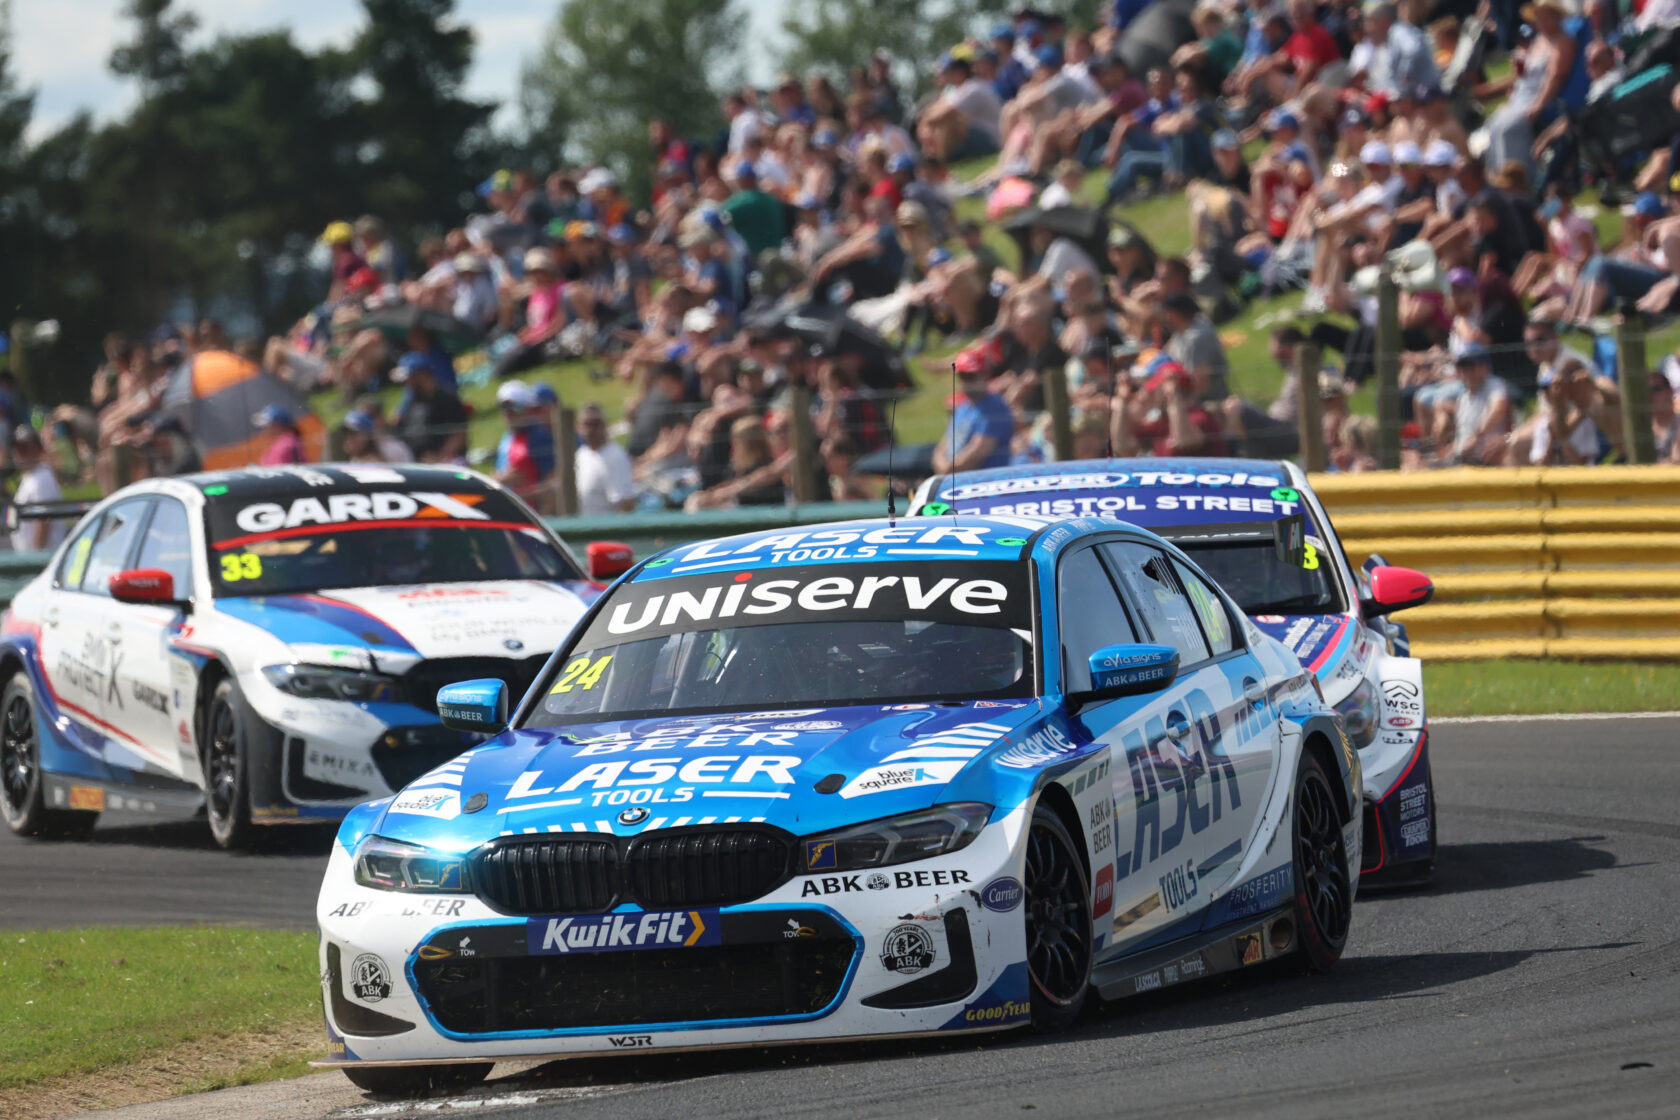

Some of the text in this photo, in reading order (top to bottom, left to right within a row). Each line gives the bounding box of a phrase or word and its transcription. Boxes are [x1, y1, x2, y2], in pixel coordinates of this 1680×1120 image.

[1132, 470, 1280, 488] Tools
[236, 491, 491, 533] GARDX
[989, 495, 1146, 516] BRISTOL
[1156, 494, 1298, 516] STREET
[681, 526, 993, 563] LASER
[770, 545, 879, 564] TOOLS
[220, 553, 262, 582] 33
[1132, 652, 1162, 665] signs
[549, 655, 614, 695] 24
[1105, 668, 1164, 688] ABK BEER
[1386, 700, 1420, 711] WSC
[461, 711, 484, 721] BEER
[573, 721, 774, 745] ABK
[571, 731, 800, 757] BEER
[504, 754, 802, 800] LASER
[858, 775, 914, 791] square
[878, 769, 914, 780] blue
[590, 786, 695, 807] TOOLS
[1400, 782, 1428, 801] BRISTOL
[1090, 798, 1106, 830] ABK
[1400, 795, 1426, 813] STREET
[1093, 824, 1112, 855] BEER
[801, 868, 972, 898] ABK BEER
[1158, 858, 1198, 914] TOOLS
[988, 885, 1021, 905] Carrier
[459, 948, 476, 957] TOW
[895, 955, 923, 968] ABK
[361, 985, 382, 997] ABK
[607, 1035, 653, 1046] WSR
